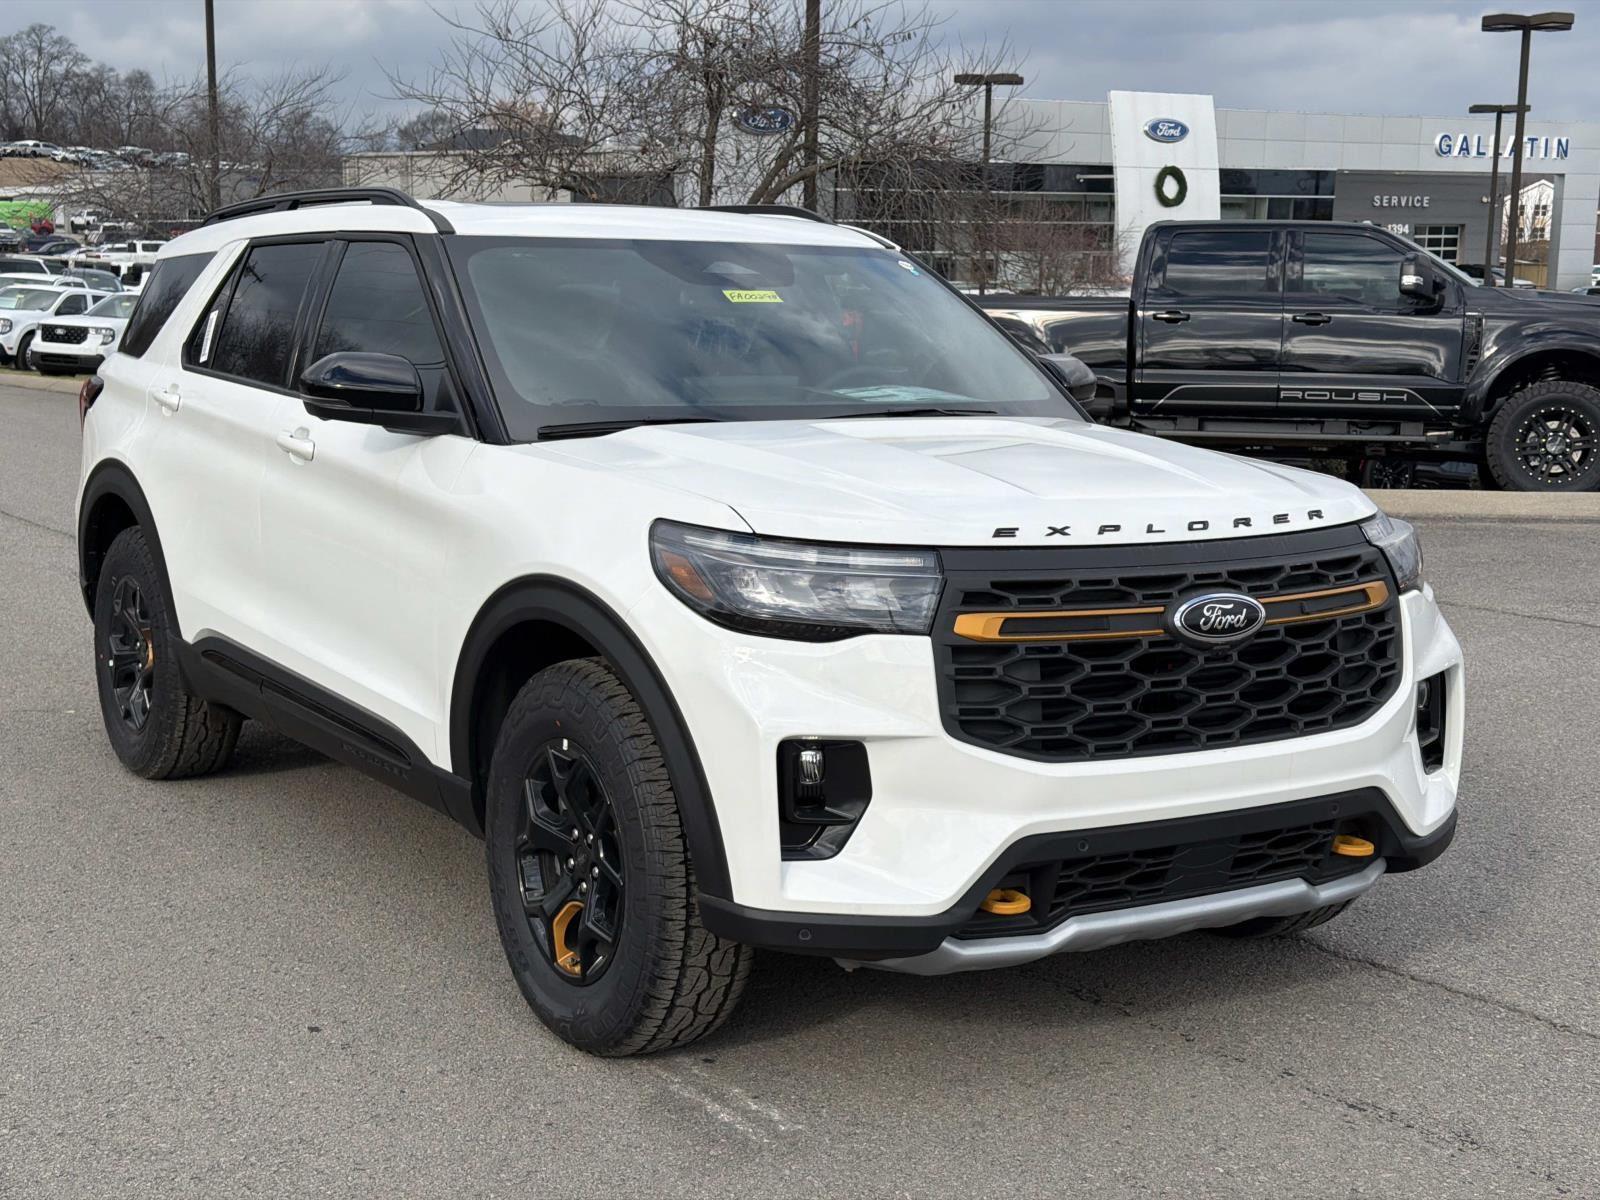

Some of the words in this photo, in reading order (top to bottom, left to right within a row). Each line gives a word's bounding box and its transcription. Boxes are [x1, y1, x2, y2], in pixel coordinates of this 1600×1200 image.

[1156, 122, 1181, 137] Ford
[1372, 194, 1431, 209] SERVICE
[1280, 390, 1408, 402] ROUSH
[991, 508, 1325, 539] EXPLORER
[1199, 603, 1248, 631] Ford
